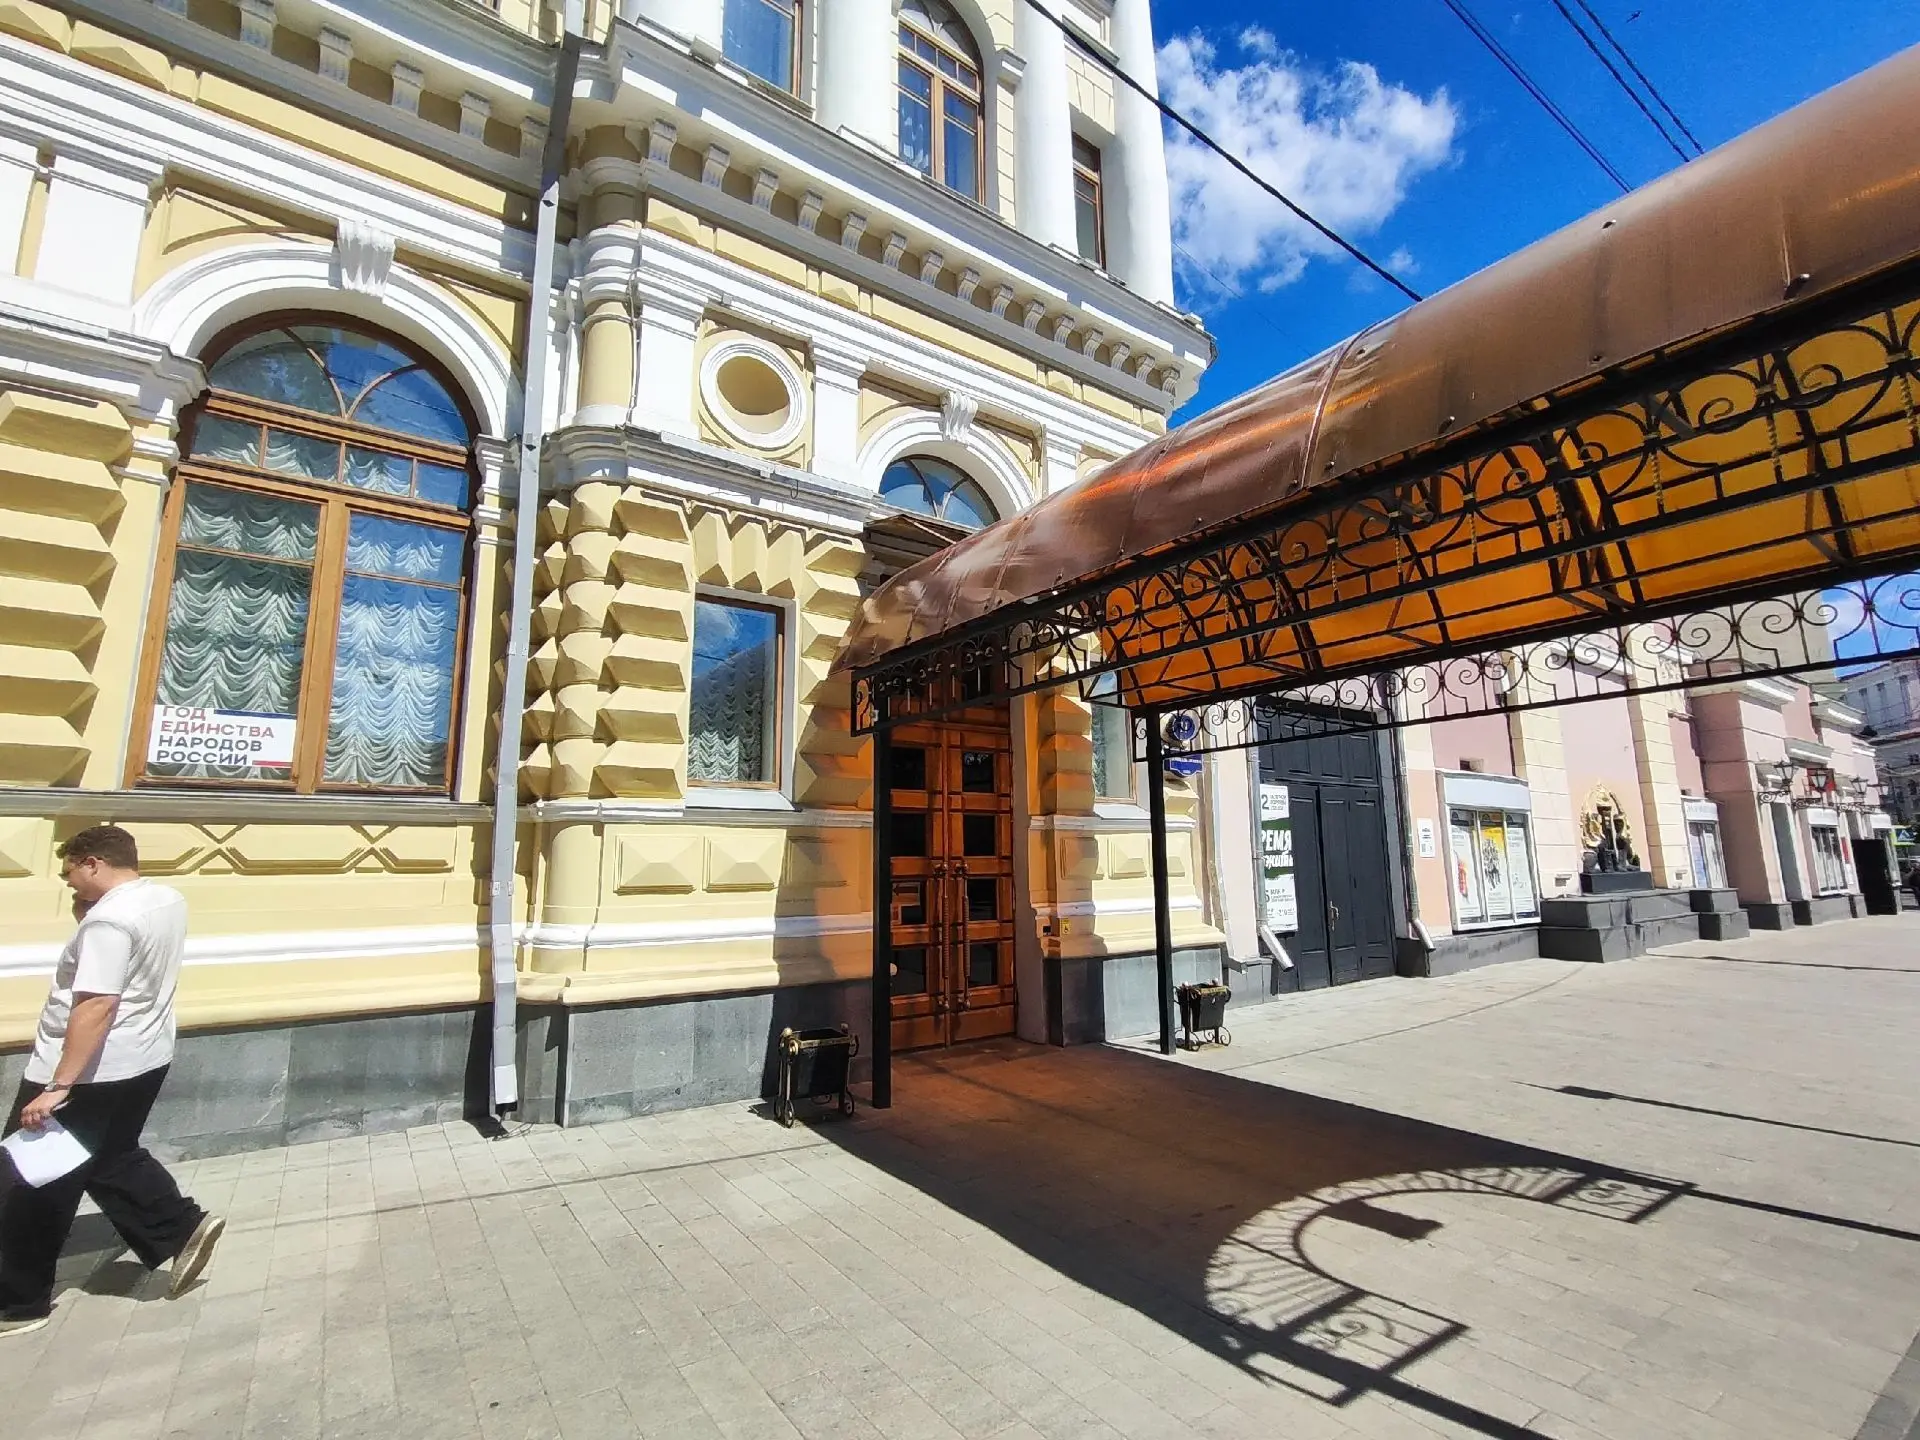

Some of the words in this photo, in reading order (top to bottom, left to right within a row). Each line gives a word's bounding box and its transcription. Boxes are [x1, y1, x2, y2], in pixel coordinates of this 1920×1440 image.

[162, 705, 206, 721] ГОД
[160, 720, 275, 738] ЕДИНСТВА
[158, 735, 263, 753] НАРОДОВ
[156, 750, 248, 765] РОССИИ
